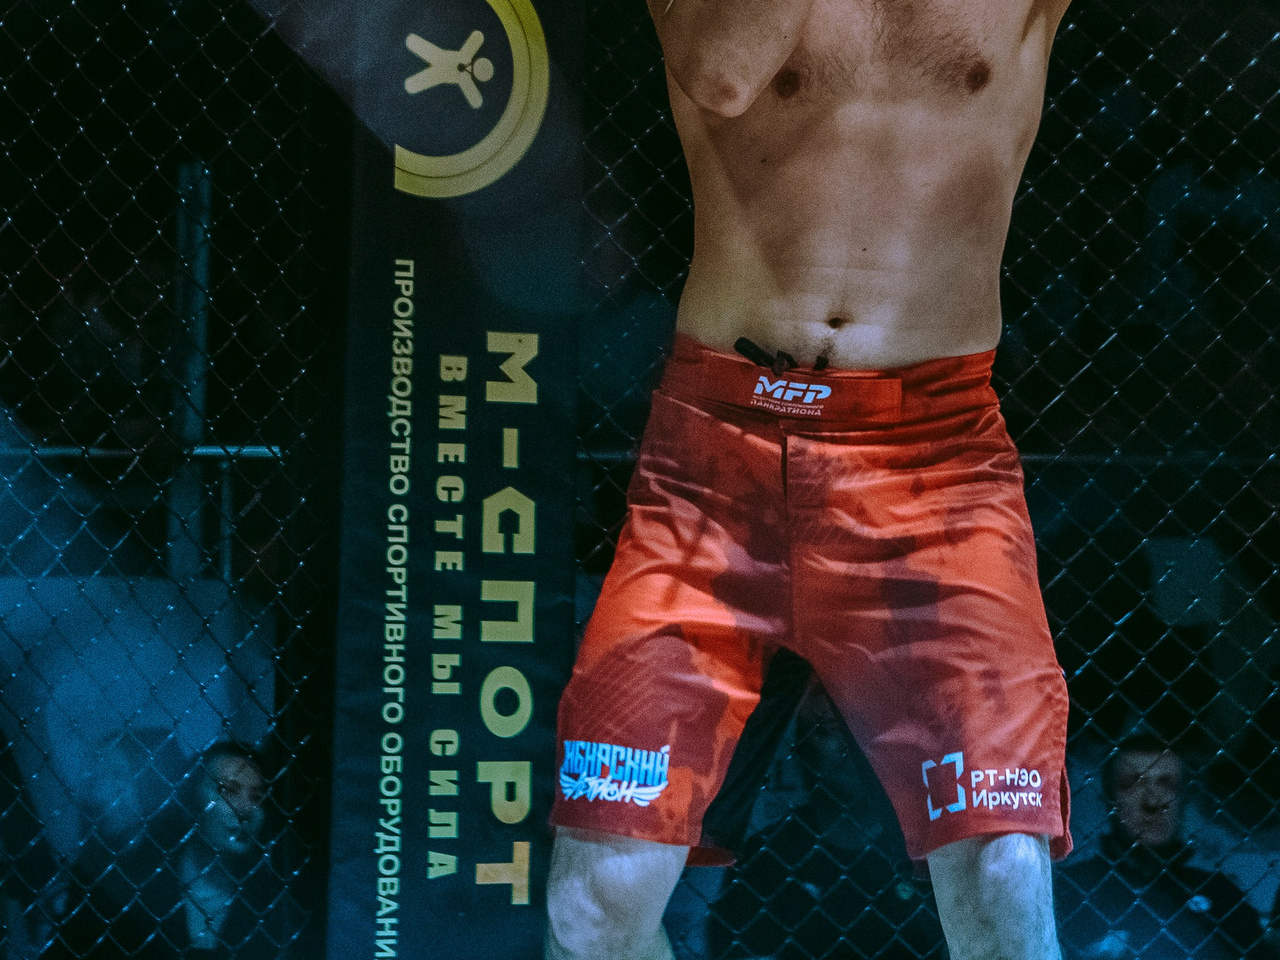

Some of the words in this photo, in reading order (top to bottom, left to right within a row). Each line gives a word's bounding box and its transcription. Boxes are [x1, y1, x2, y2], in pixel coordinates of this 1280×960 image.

[386, 258, 416, 496] ПРОИЗВОДСТВО
[754, 375, 832, 404] MFP
[434, 354, 468, 572] ВМЕСТЕ
[380, 503, 409, 725] СПОРТИВНОГО
[431, 604, 463, 695] МЫ
[374, 732, 404, 960] ОБОРУДОВАНИ
[427, 728, 461, 880] СИЛА
[971, 767, 1042, 789] РТ-НЭО
[972, 788, 1043, 810] Иркутск
